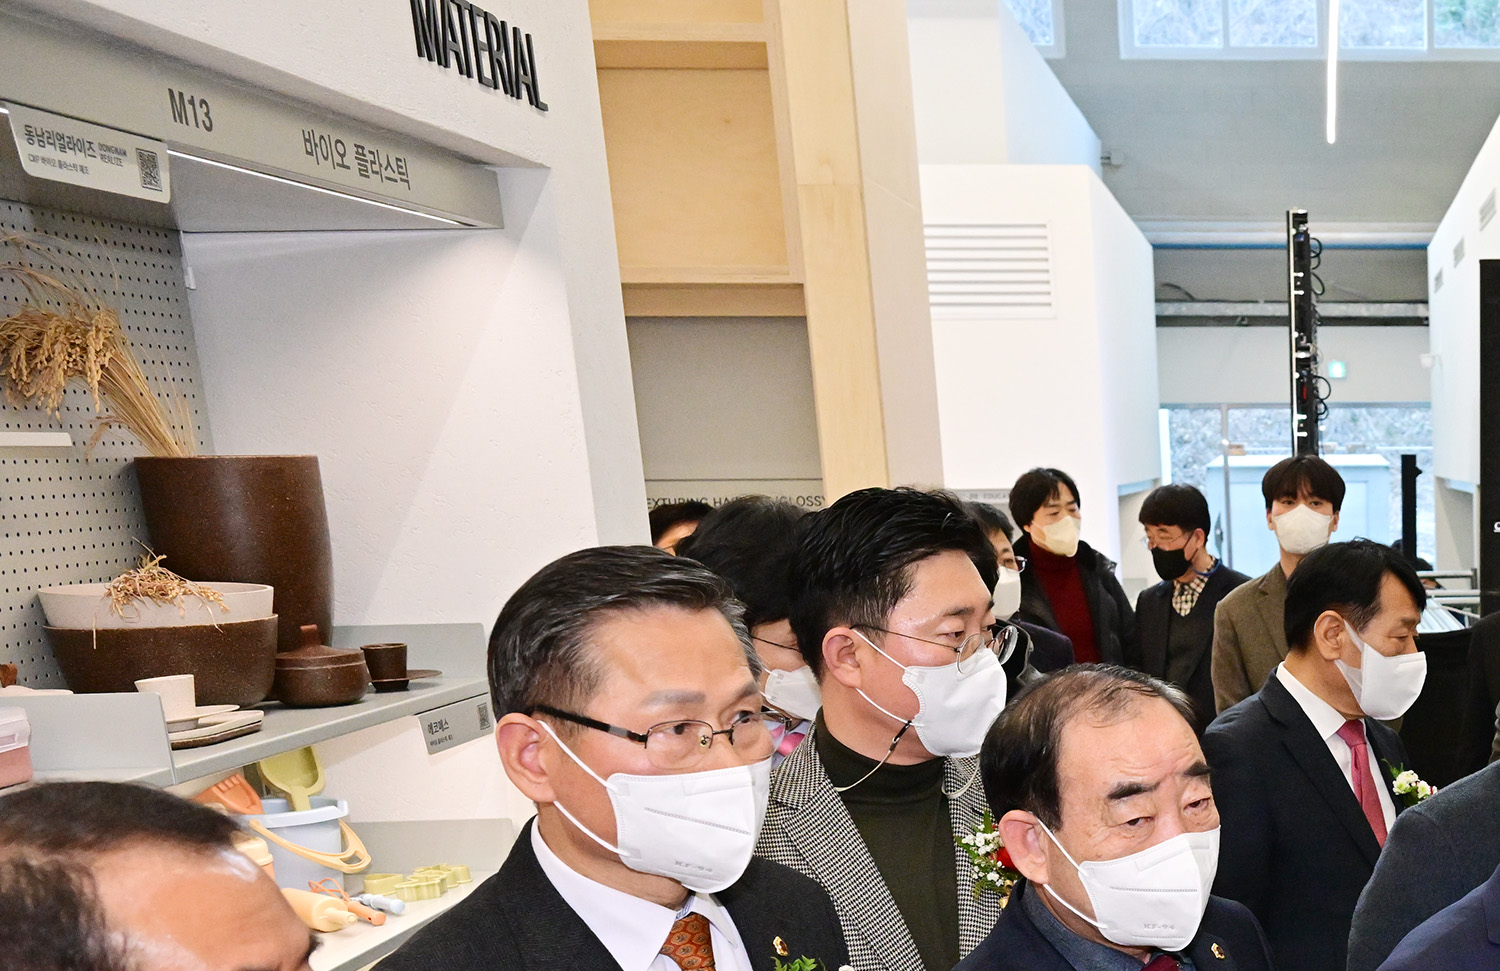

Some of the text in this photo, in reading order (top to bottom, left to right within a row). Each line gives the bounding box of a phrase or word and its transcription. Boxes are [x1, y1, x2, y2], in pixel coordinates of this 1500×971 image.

[410, 0, 549, 112] MATERIAL
[168, 88, 213, 132] M13
[24, 124, 97, 158] 동남리얼라이즈
[301, 129, 411, 191] 바이오 플라스틱
